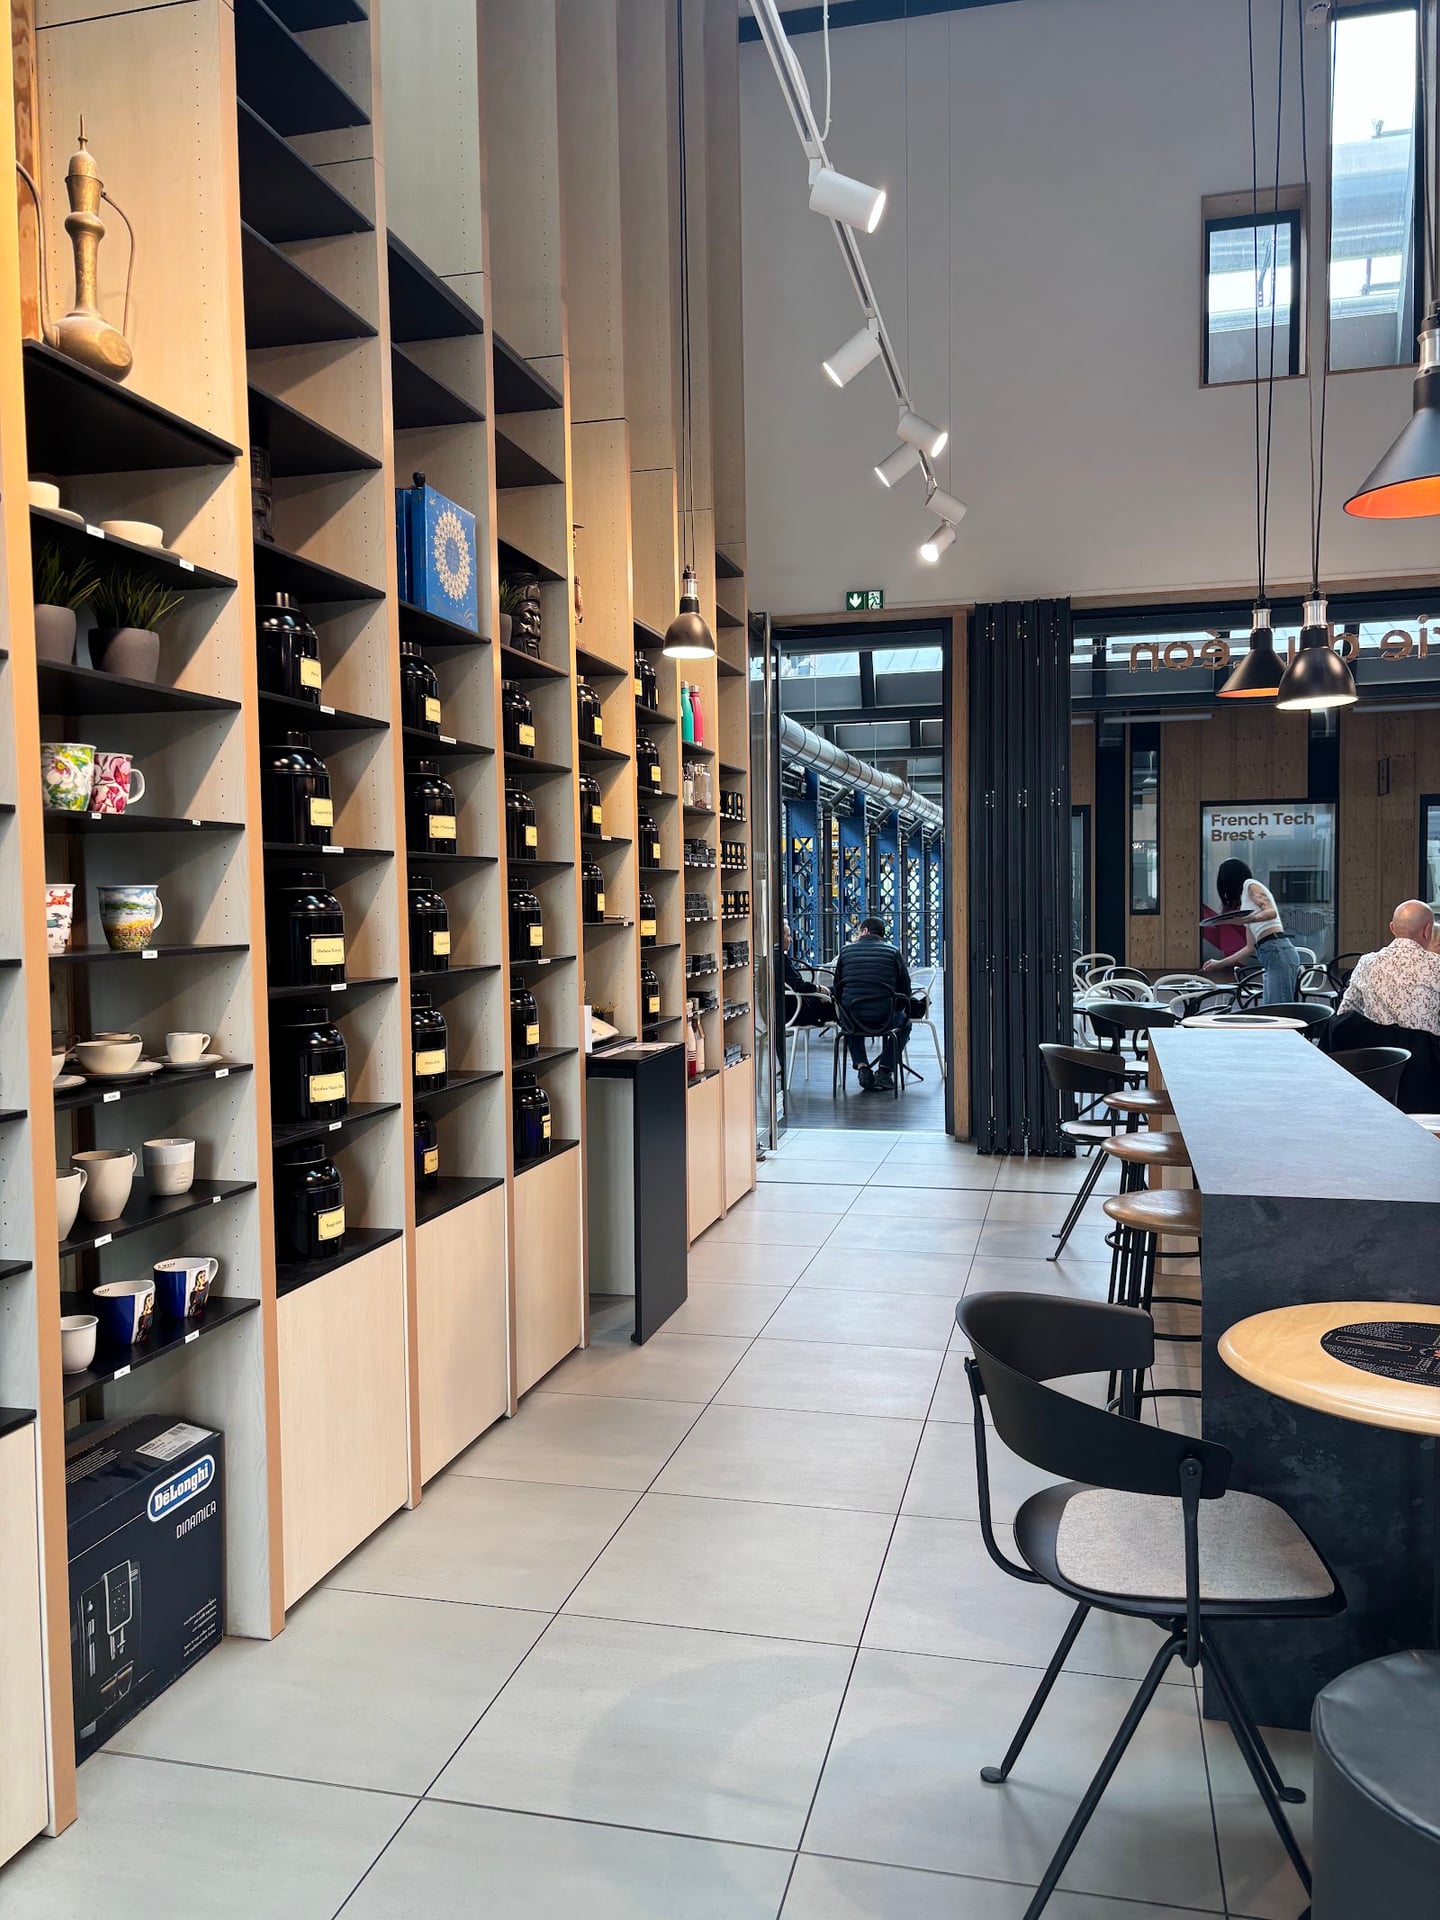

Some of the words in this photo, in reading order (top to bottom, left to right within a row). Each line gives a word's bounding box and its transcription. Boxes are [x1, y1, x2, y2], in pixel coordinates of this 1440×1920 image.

[1211, 812, 1269, 827] French
[1273, 811, 1315, 825] Tech
[1211, 829, 1255, 842] Brest
[176, 1500, 217, 1539] DINAMICA
